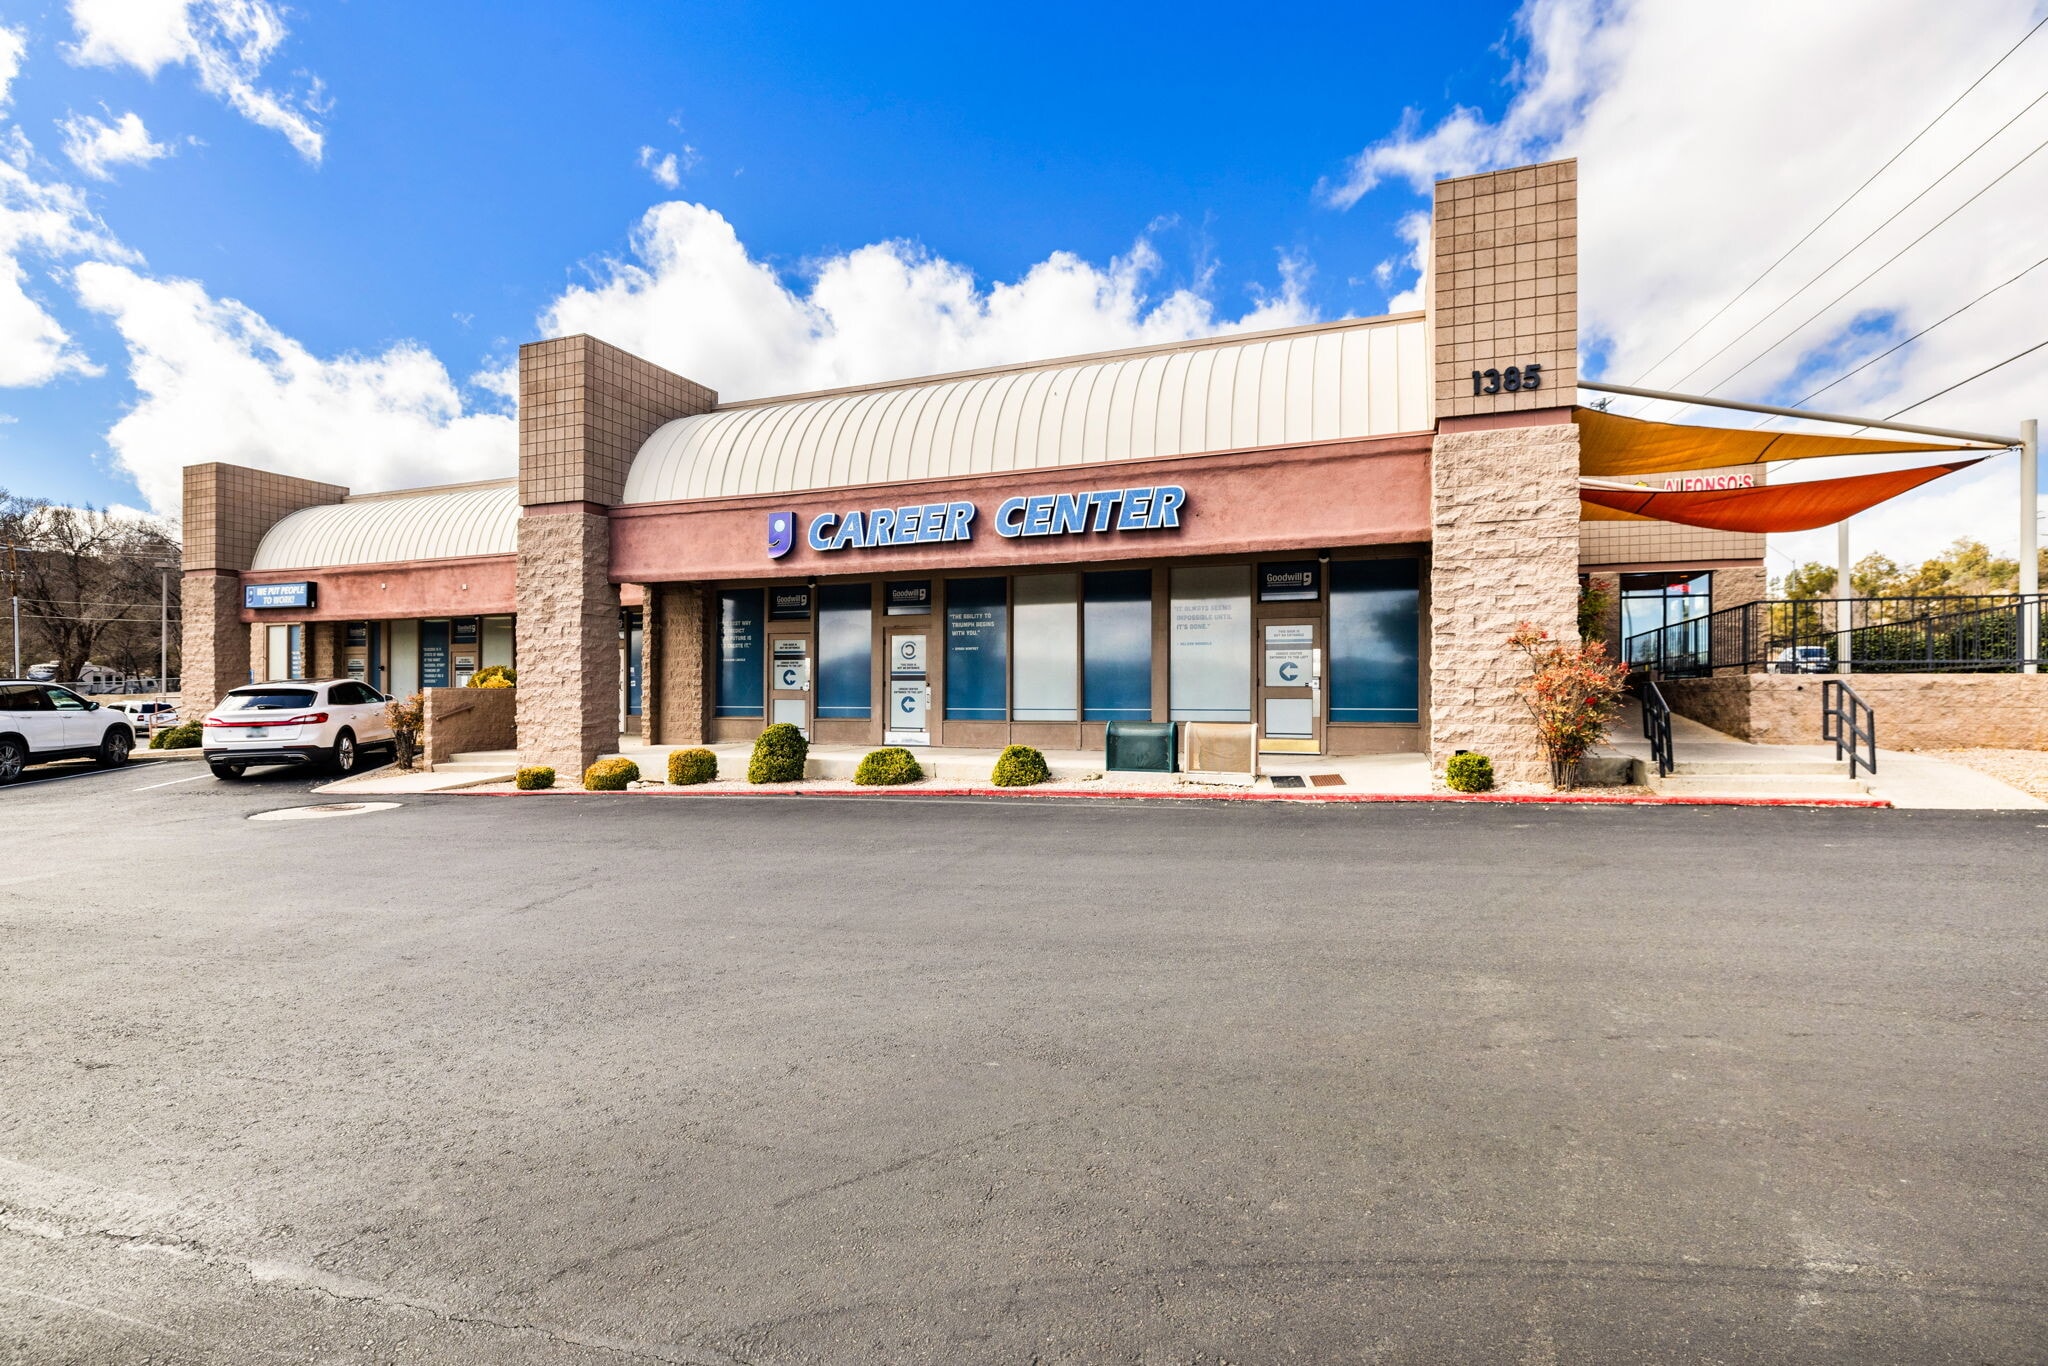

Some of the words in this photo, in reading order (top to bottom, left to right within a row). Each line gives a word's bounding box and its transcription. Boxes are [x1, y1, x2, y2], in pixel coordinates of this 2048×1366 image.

[1472, 364, 1541, 396] 1385
[808, 501, 976, 551] CAREER
[995, 485, 1186, 538] CENTER
[1266, 573, 1303, 582] Goodwill
[257, 587, 268, 596] WE
[268, 587, 281, 596] PUT
[281, 585, 305, 595] PEOPLE
[892, 589, 919, 598] Goodwill
[263, 596, 273, 605] TO
[776, 595, 801, 603] Goodwill
